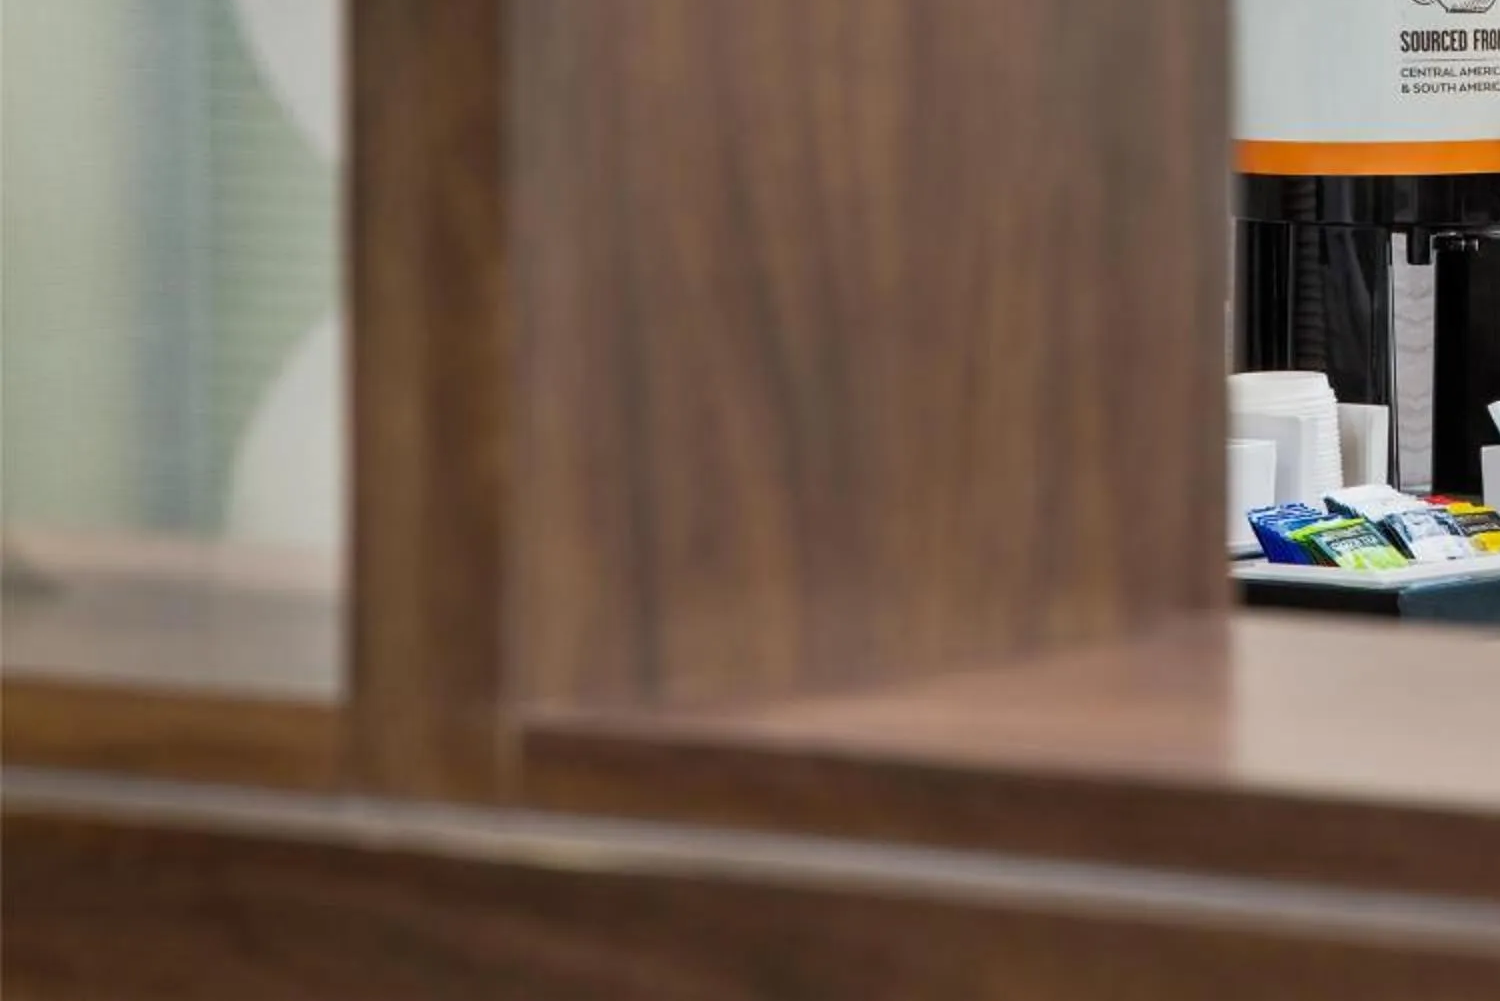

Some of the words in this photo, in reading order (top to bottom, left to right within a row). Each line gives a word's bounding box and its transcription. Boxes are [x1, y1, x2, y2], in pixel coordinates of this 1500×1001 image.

[1400, 28, 1468, 53] SOURCED
[1401, 66, 1458, 78] CENTRAL
[1413, 82, 1457, 94] SOUTH
